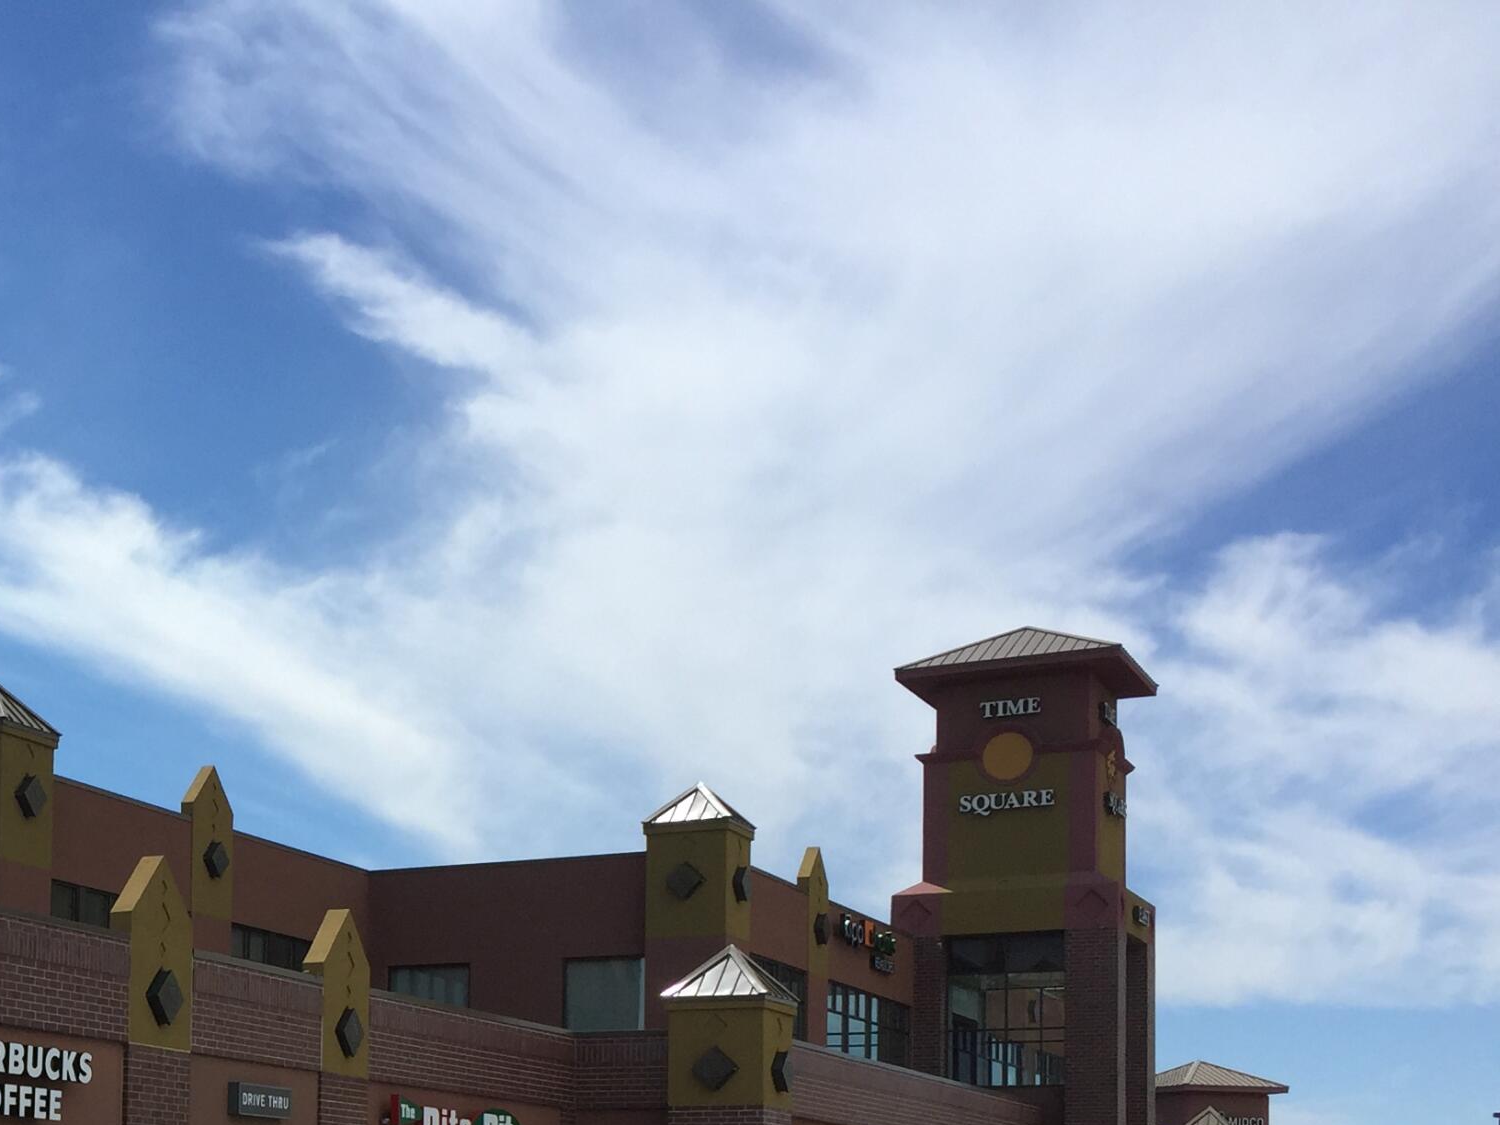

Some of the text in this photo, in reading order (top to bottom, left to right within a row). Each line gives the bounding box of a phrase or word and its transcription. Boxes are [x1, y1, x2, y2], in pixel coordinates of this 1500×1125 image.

[979, 697, 1041, 718] TIME
[959, 789, 1055, 816] SQUARE
[242, 1092, 290, 1110] DRIVE THRU
[400, 1103, 416, 1119] The
